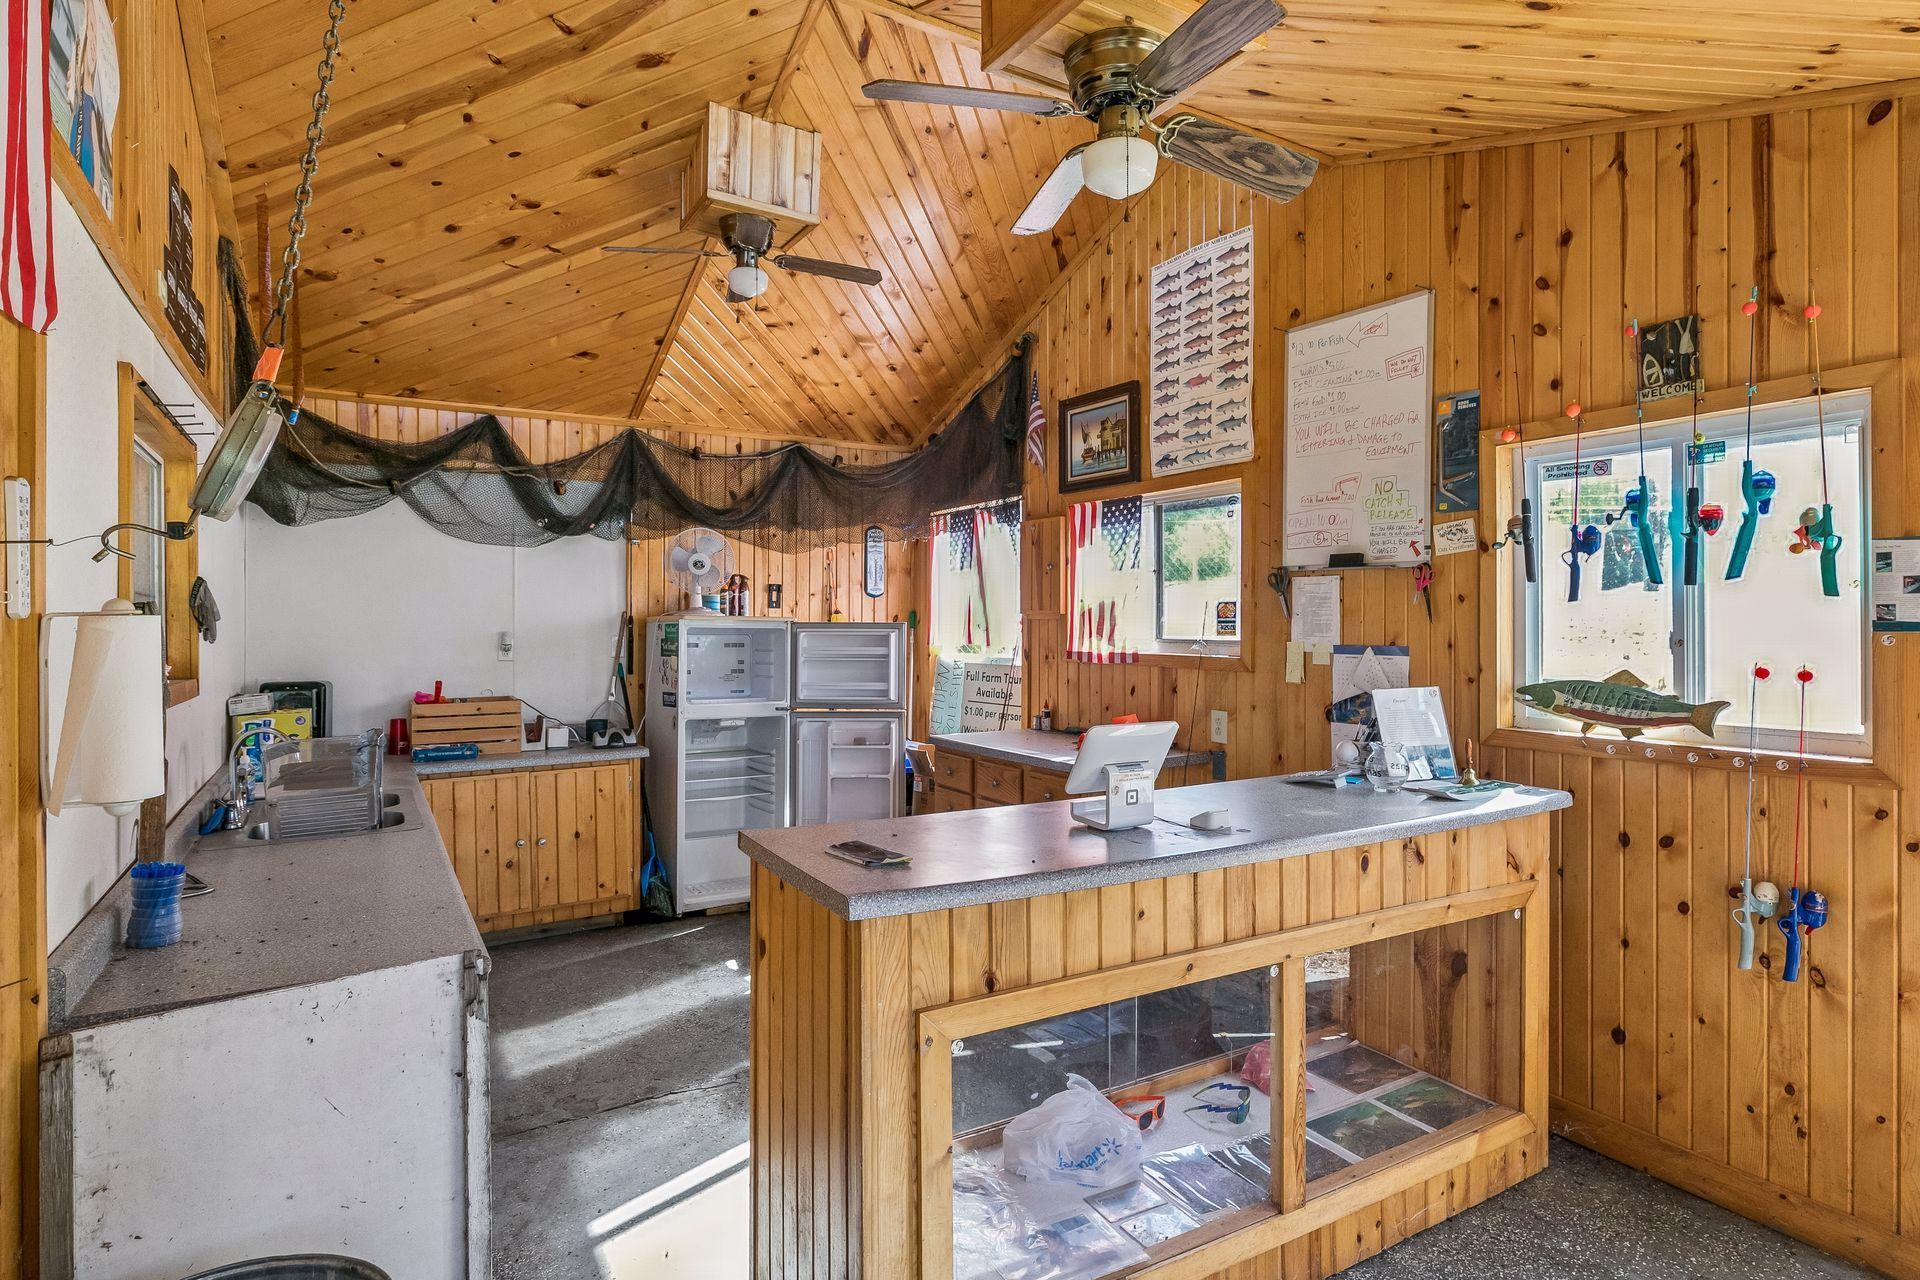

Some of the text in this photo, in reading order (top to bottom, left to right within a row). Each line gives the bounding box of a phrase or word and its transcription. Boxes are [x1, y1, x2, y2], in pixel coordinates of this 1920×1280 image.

[1211, 235, 1228, 245] NORTH
[1228, 227, 1251, 239] AMERICA
[1328, 334, 1344, 346] Fish
[1641, 381, 1696, 399] WELCOME
[1294, 426, 1310, 440] YOU
[1315, 421, 1341, 437] WILL
[1344, 420, 1359, 433] BE
[1363, 412, 1405, 429] CHARGED
[1295, 436, 1346, 453] LITTERING
[1357, 432, 1389, 445] DAMAGE
[1391, 431, 1403, 442] TO
[1365, 442, 1418, 457] EQUIPMENT
[1545, 466, 1555, 474] All
[1547, 470, 1588, 479] Prohibied
[1375, 480, 1394, 495] NO
[1364, 495, 1394, 509] CATCH
[1370, 508, 1415, 520] RELEASE
[1371, 546, 1398, 554] CHARGED
[965, 670, 980, 682] Full
[981, 671, 1002, 683] Farm
[930, 663, 950, 735] RETURN
[976, 686, 1014, 700] Availabe
[964, 705, 984, 717] $1.00
[984, 710, 997, 720] per
